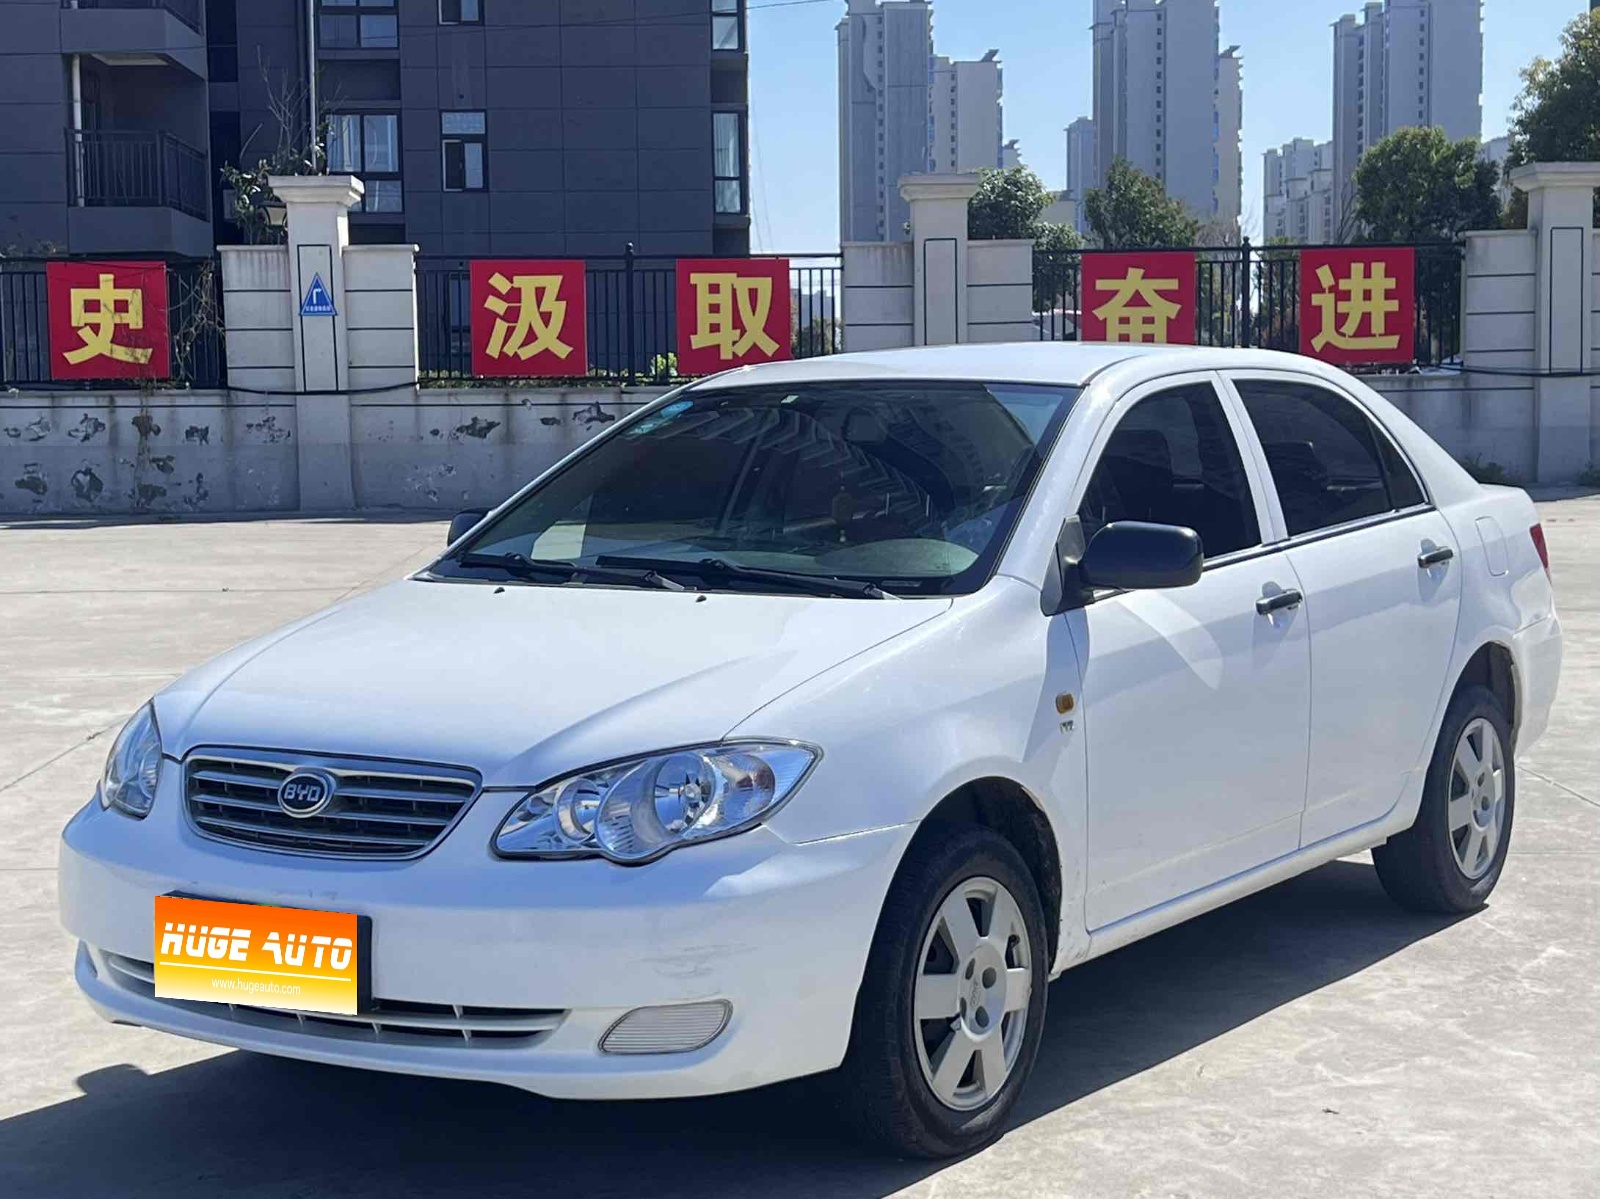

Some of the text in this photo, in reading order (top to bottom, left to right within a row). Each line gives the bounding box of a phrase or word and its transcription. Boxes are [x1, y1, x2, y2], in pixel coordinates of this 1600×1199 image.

[63, 273, 153, 364] 史
[484, 272, 574, 361] 汲
[690, 272, 780, 360] 取
[1092, 267, 1182, 343] 奋
[1311, 261, 1400, 353] 进
[284, 783, 321, 802] BYD
